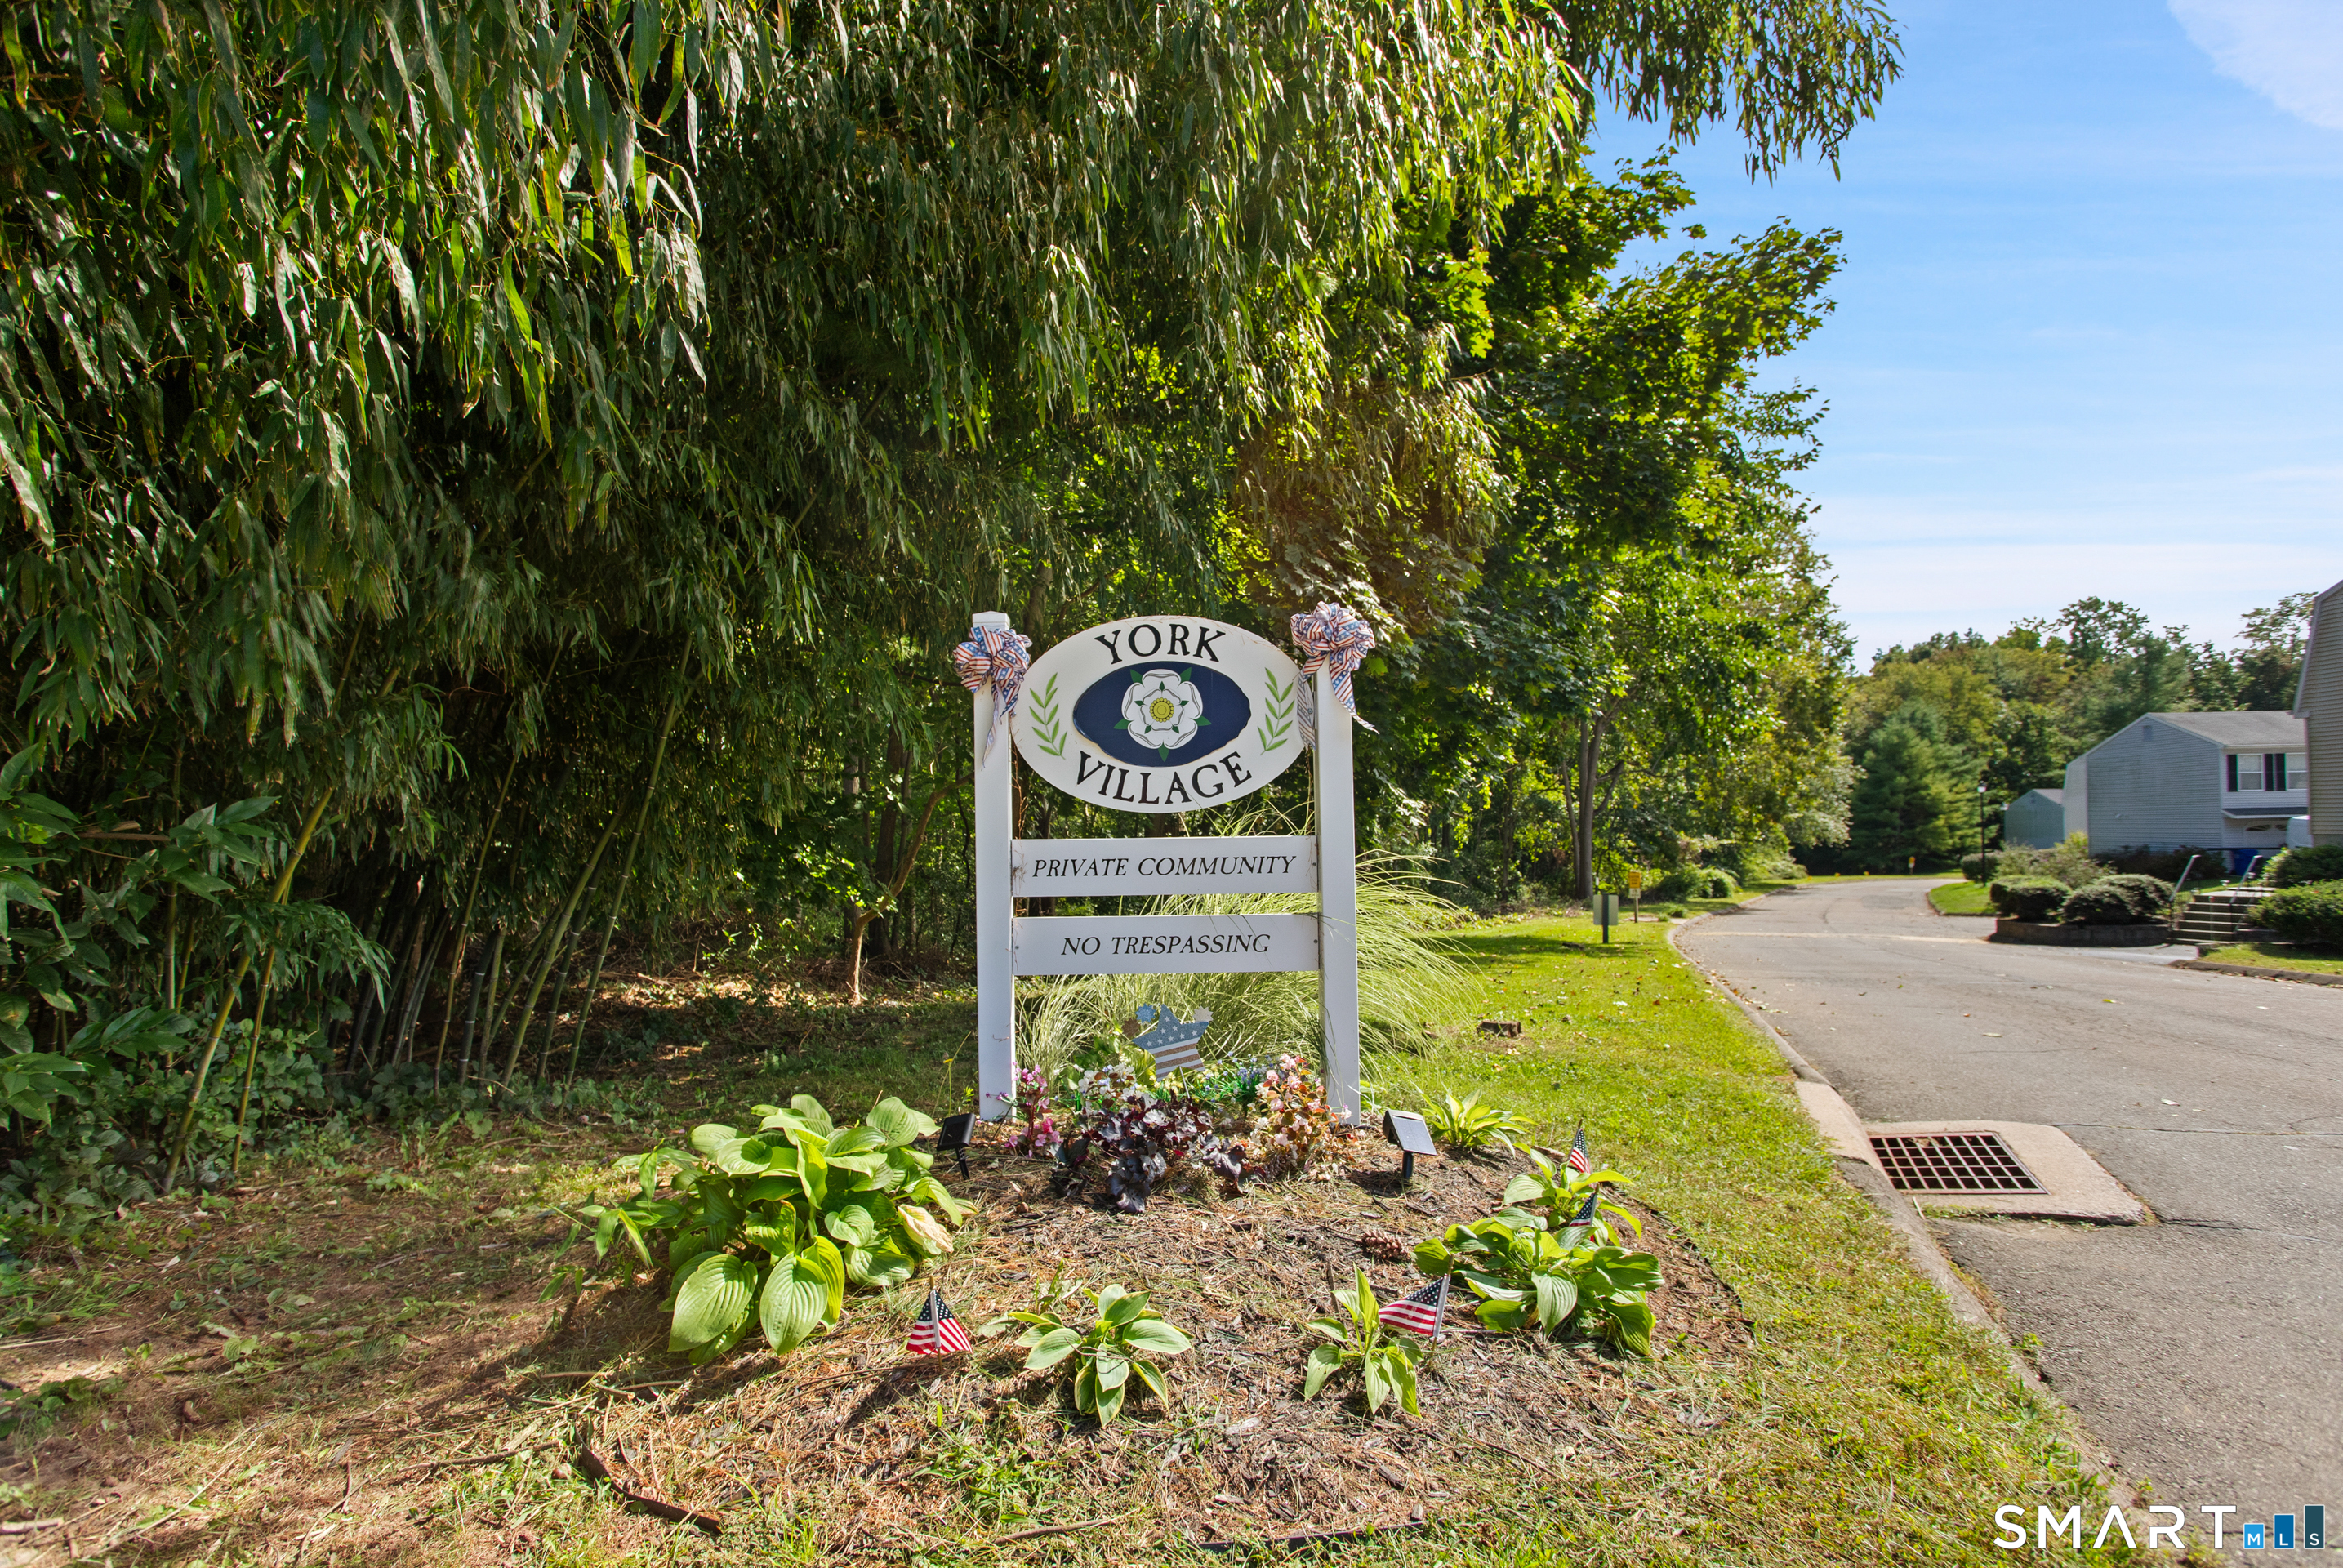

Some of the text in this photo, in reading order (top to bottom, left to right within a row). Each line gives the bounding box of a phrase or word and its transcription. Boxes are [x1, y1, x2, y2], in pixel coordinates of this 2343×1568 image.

[1094, 624, 1226, 664] YORK
[1076, 751, 1253, 804] VILLAGE
[1032, 855, 1297, 877] PRIVATE COMMUNITY
[1061, 933, 1271, 956] NO TRESPASSING
